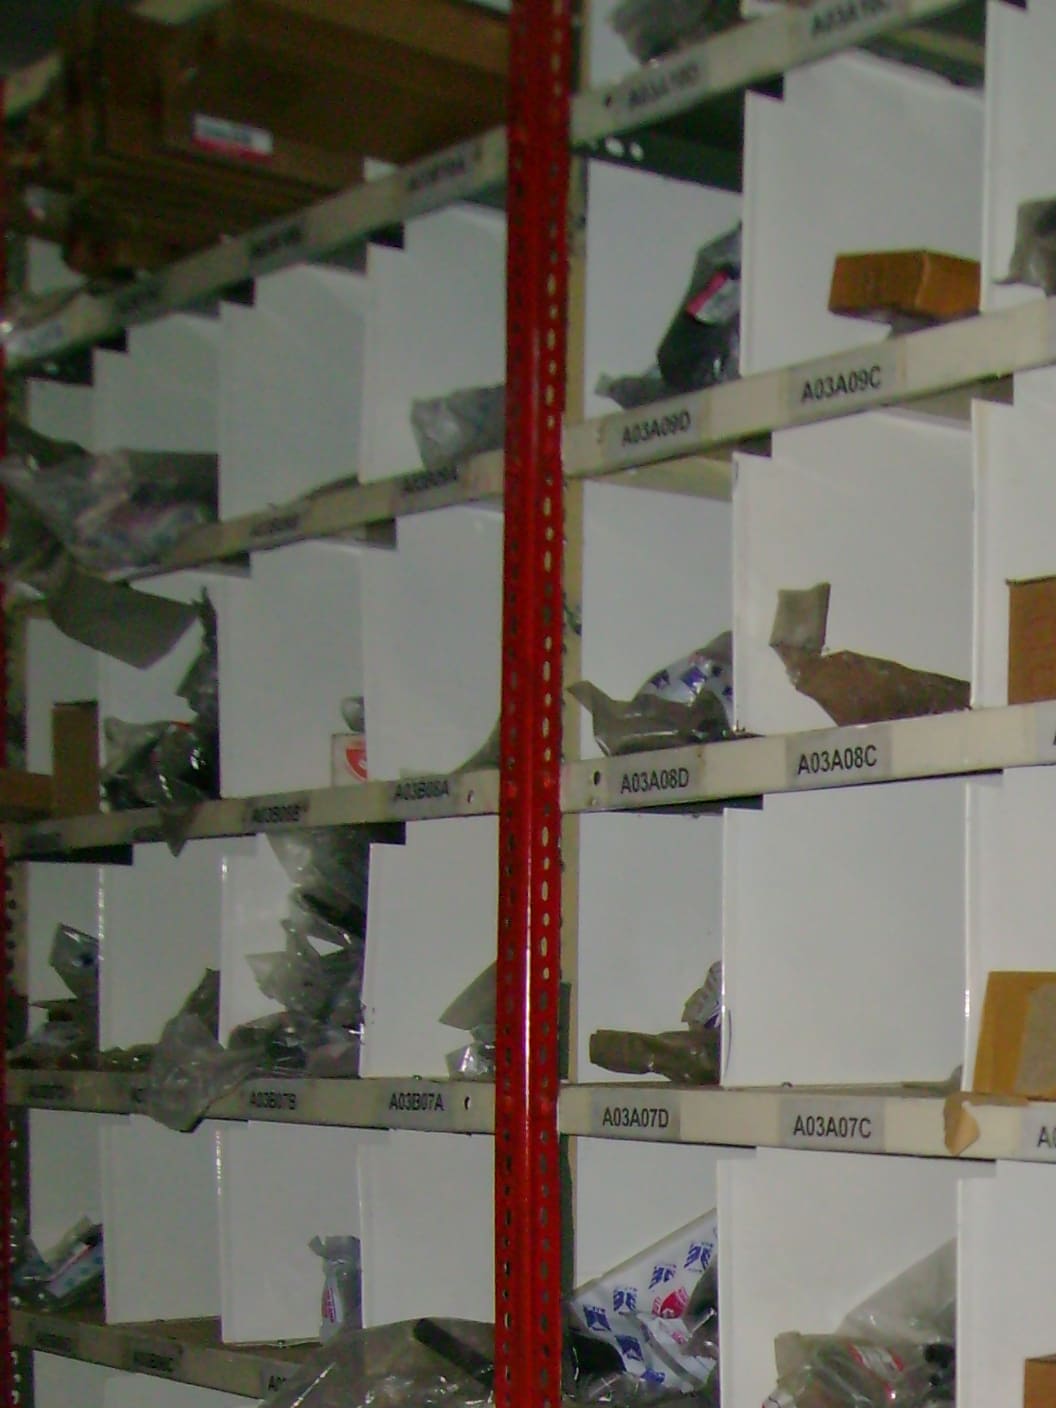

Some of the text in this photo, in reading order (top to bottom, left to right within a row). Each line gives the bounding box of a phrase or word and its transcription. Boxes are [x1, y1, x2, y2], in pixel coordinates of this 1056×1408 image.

[800, 365, 883, 404] A03A09C
[796, 743, 878, 777] A03A08C
[620, 768, 690, 795] A03A08D
[389, 1091, 445, 1113] A03B07A
[601, 1104, 670, 1129] A03A07D
[792, 1115, 873, 1140] A03A07C
